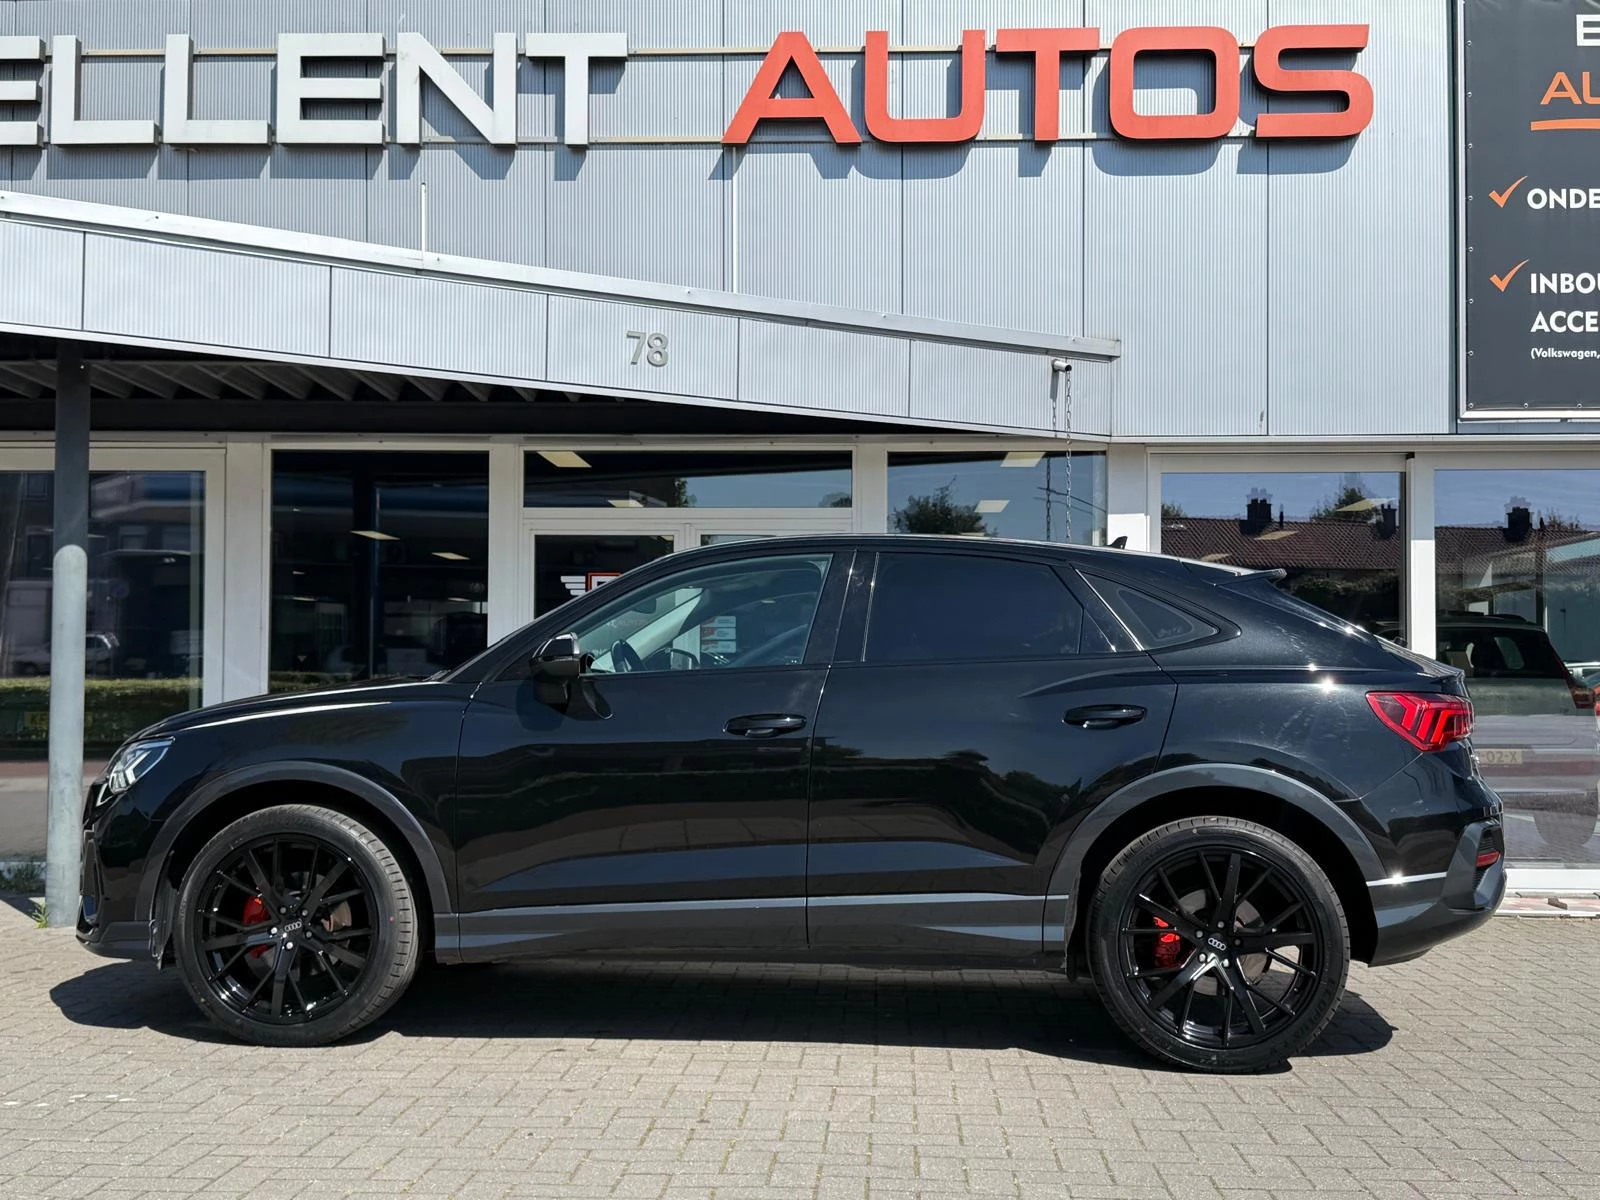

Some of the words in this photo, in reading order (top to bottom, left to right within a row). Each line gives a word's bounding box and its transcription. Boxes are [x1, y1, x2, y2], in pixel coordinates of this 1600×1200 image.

[721, 24, 1374, 144] AUTOS
[1526, 188, 1600, 210] ONDE
[1530, 272, 1600, 294] INBO
[1530, 311, 1599, 333] ACCE
[626, 330, 669, 367] 78
[1530, 347, 1600, 360] (Volkswagen,
